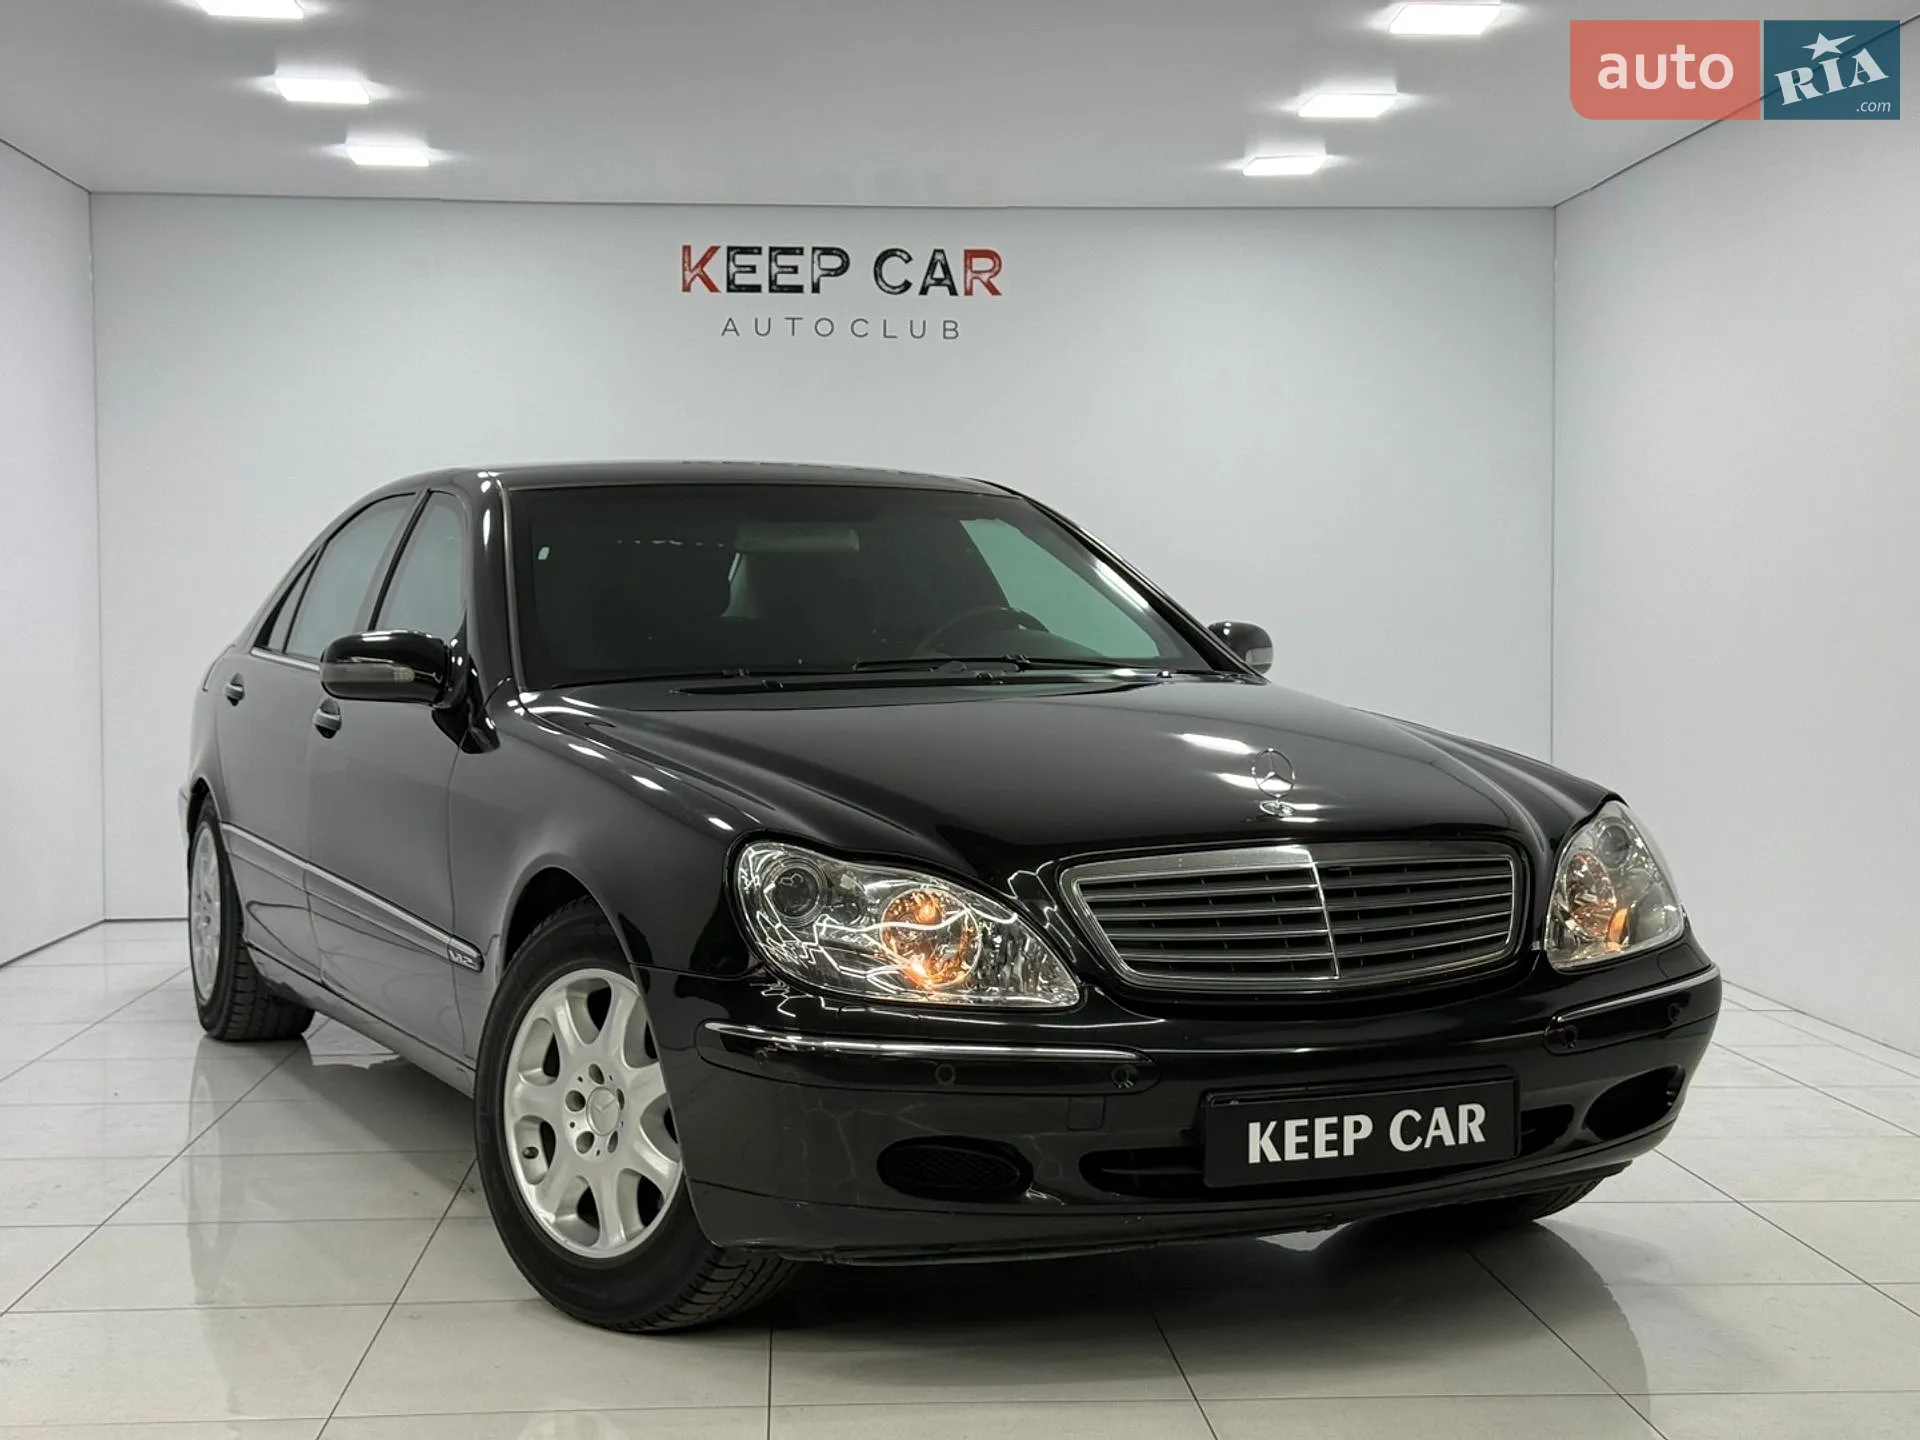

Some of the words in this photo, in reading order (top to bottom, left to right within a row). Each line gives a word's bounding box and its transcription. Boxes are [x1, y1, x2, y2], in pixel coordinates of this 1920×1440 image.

[681, 244, 851, 294] KEEP
[873, 247, 1003, 296] CAR
[721, 316, 960, 340] AUTOCLUB
[1248, 1114, 1373, 1164] KEEP
[1389, 1103, 1486, 1151] CAR
